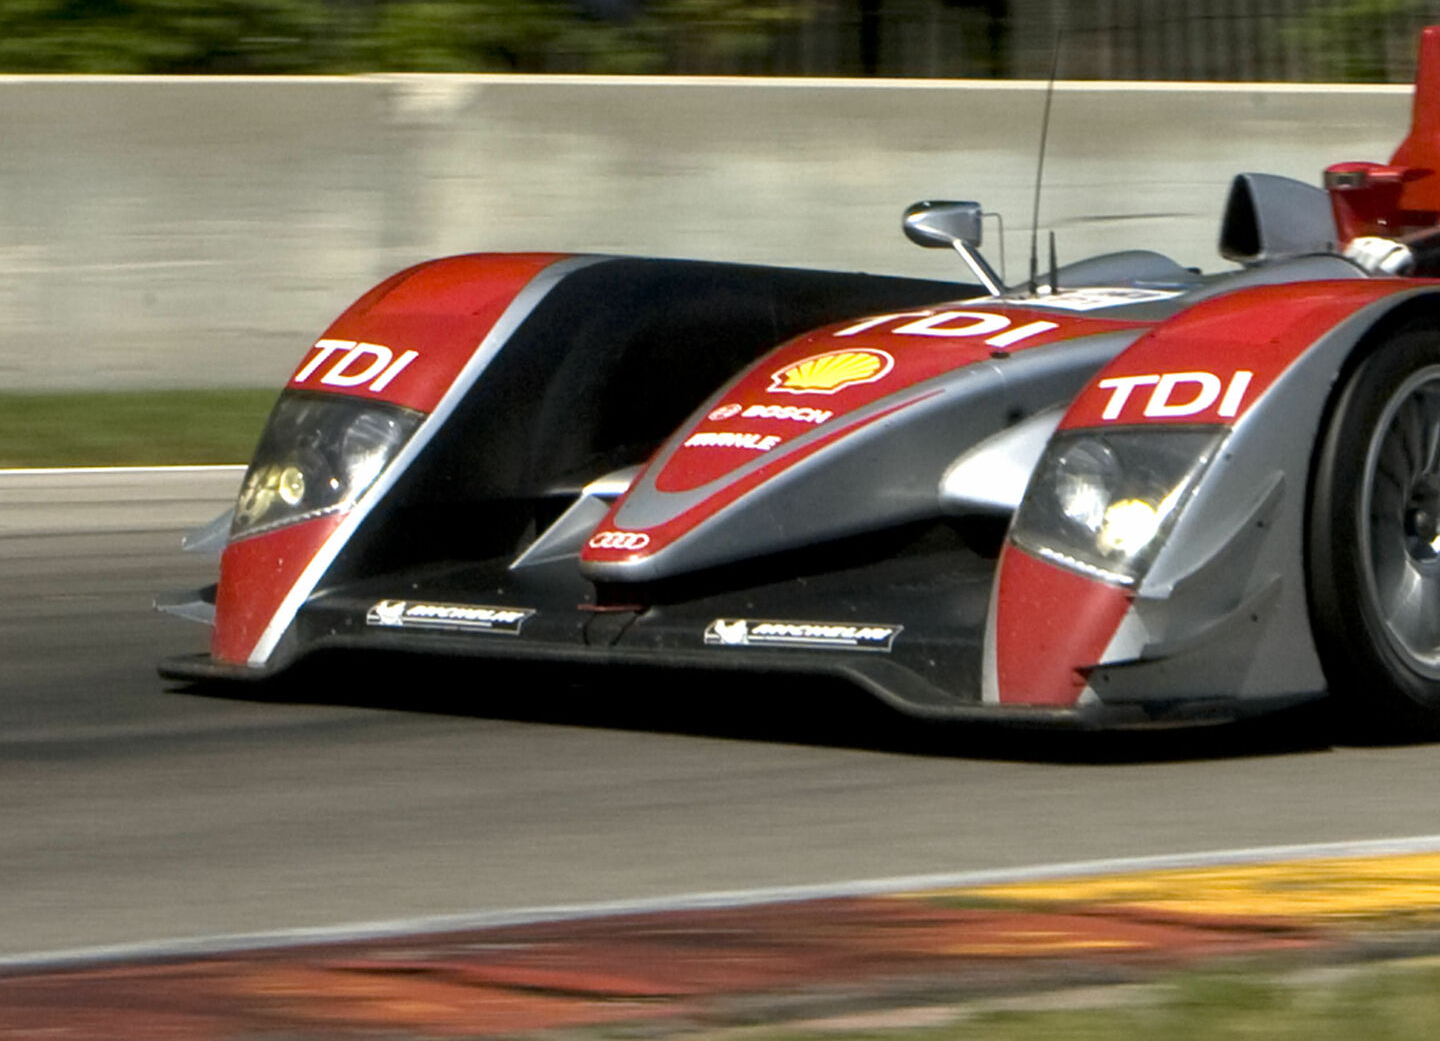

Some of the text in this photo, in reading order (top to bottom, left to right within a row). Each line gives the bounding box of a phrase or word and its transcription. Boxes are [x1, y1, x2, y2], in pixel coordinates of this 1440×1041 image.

[833, 309, 1060, 348] TDI
[294, 339, 420, 392] TDI
[741, 405, 834, 424] BOSCH
[1098, 370, 1254, 420] TDI
